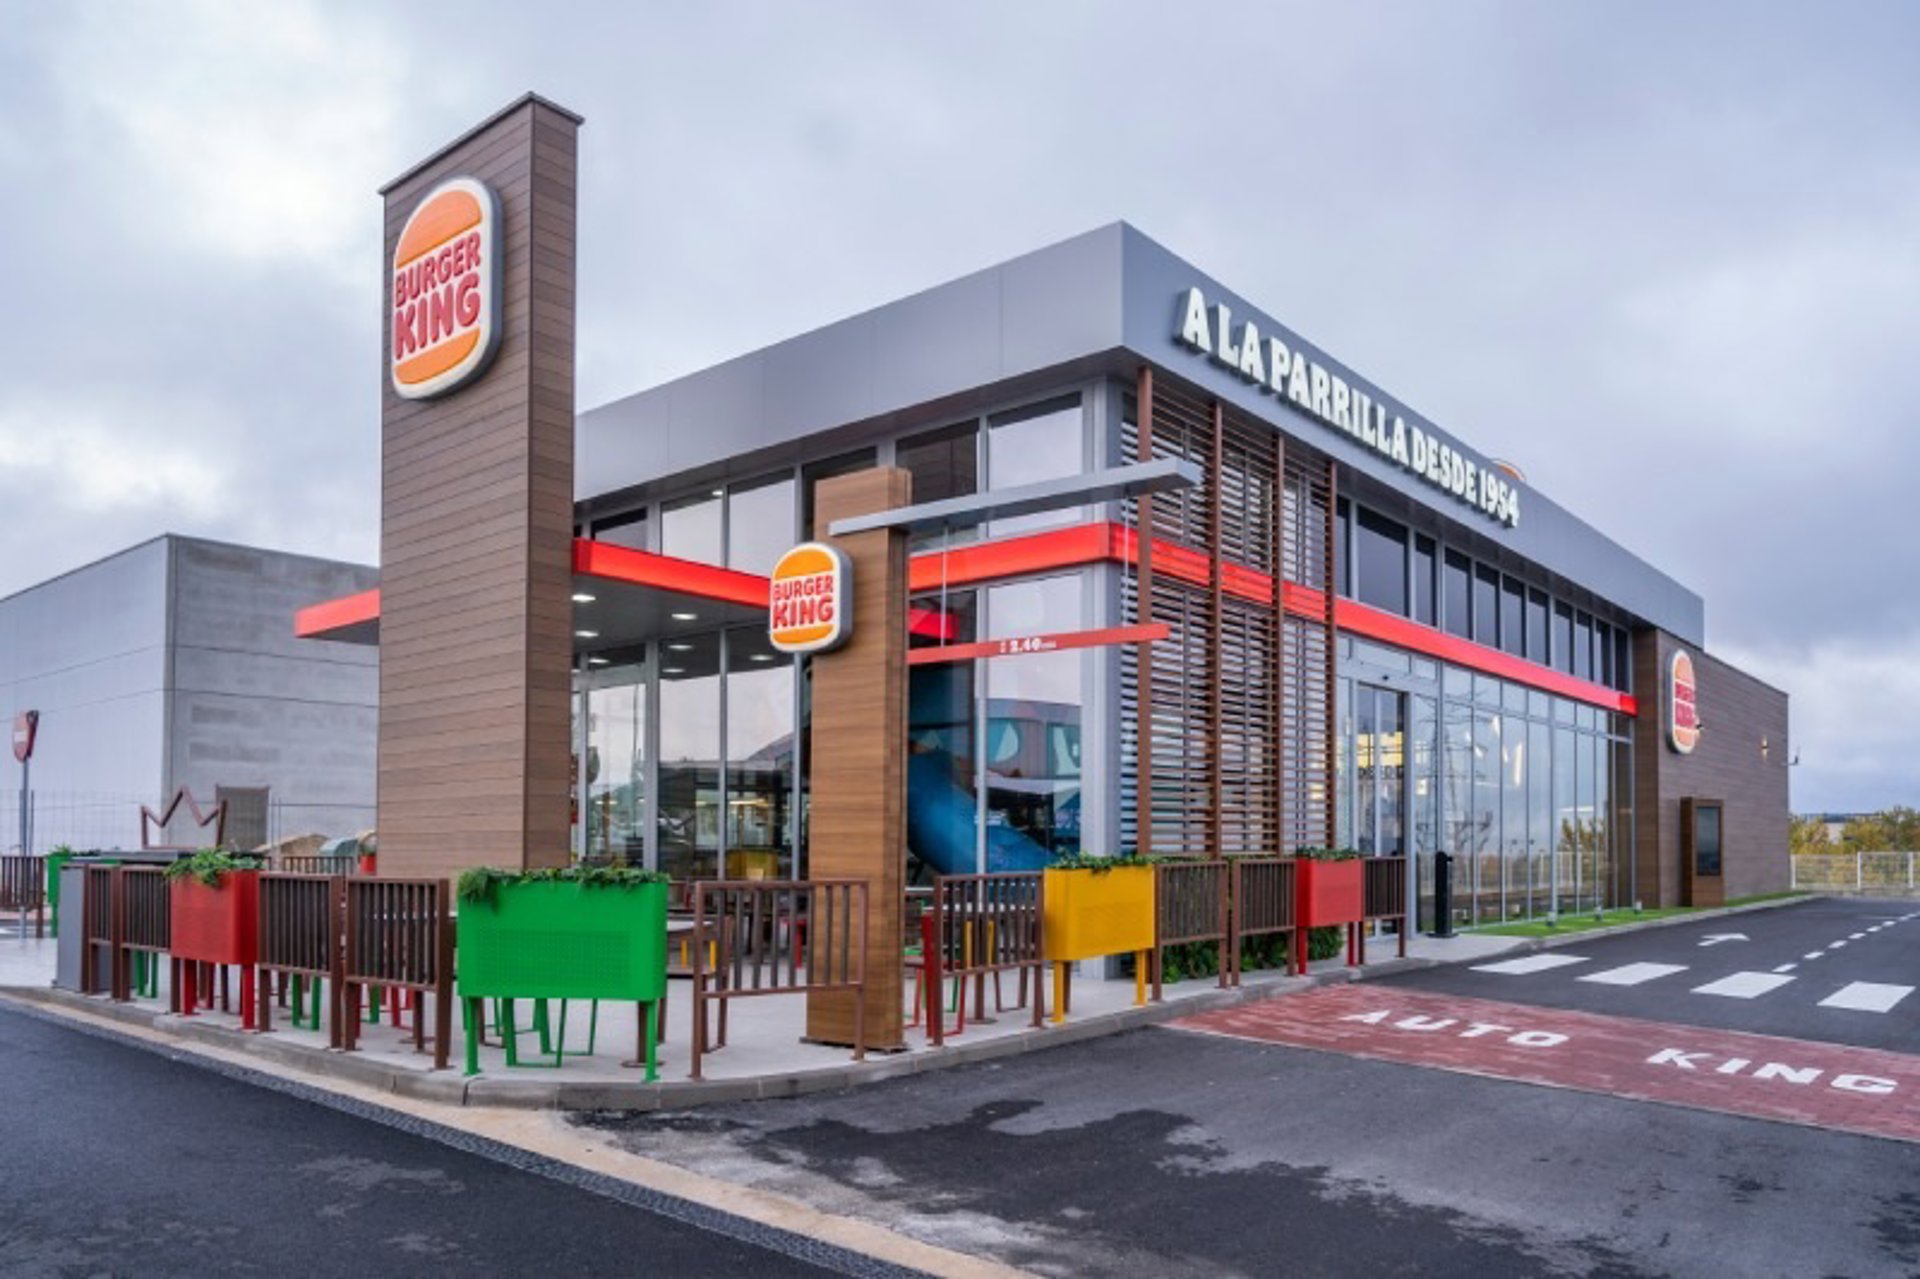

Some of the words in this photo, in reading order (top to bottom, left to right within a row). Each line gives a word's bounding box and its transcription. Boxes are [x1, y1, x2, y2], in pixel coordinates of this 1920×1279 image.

[396, 232, 481, 308] BURGER
[395, 272, 481, 360] KING
[1182, 286, 1211, 352] A
[1218, 302, 1265, 383] LA
[1271, 336, 1409, 467] PARRILLA
[1411, 425, 1477, 505] DESDE
[1478, 468, 1520, 528] 1954
[772, 594, 834, 629] KING
[773, 575, 834, 601] BURGER
[1339, 1009, 1569, 1048] AUTO
[1645, 1048, 1898, 1094] KING
